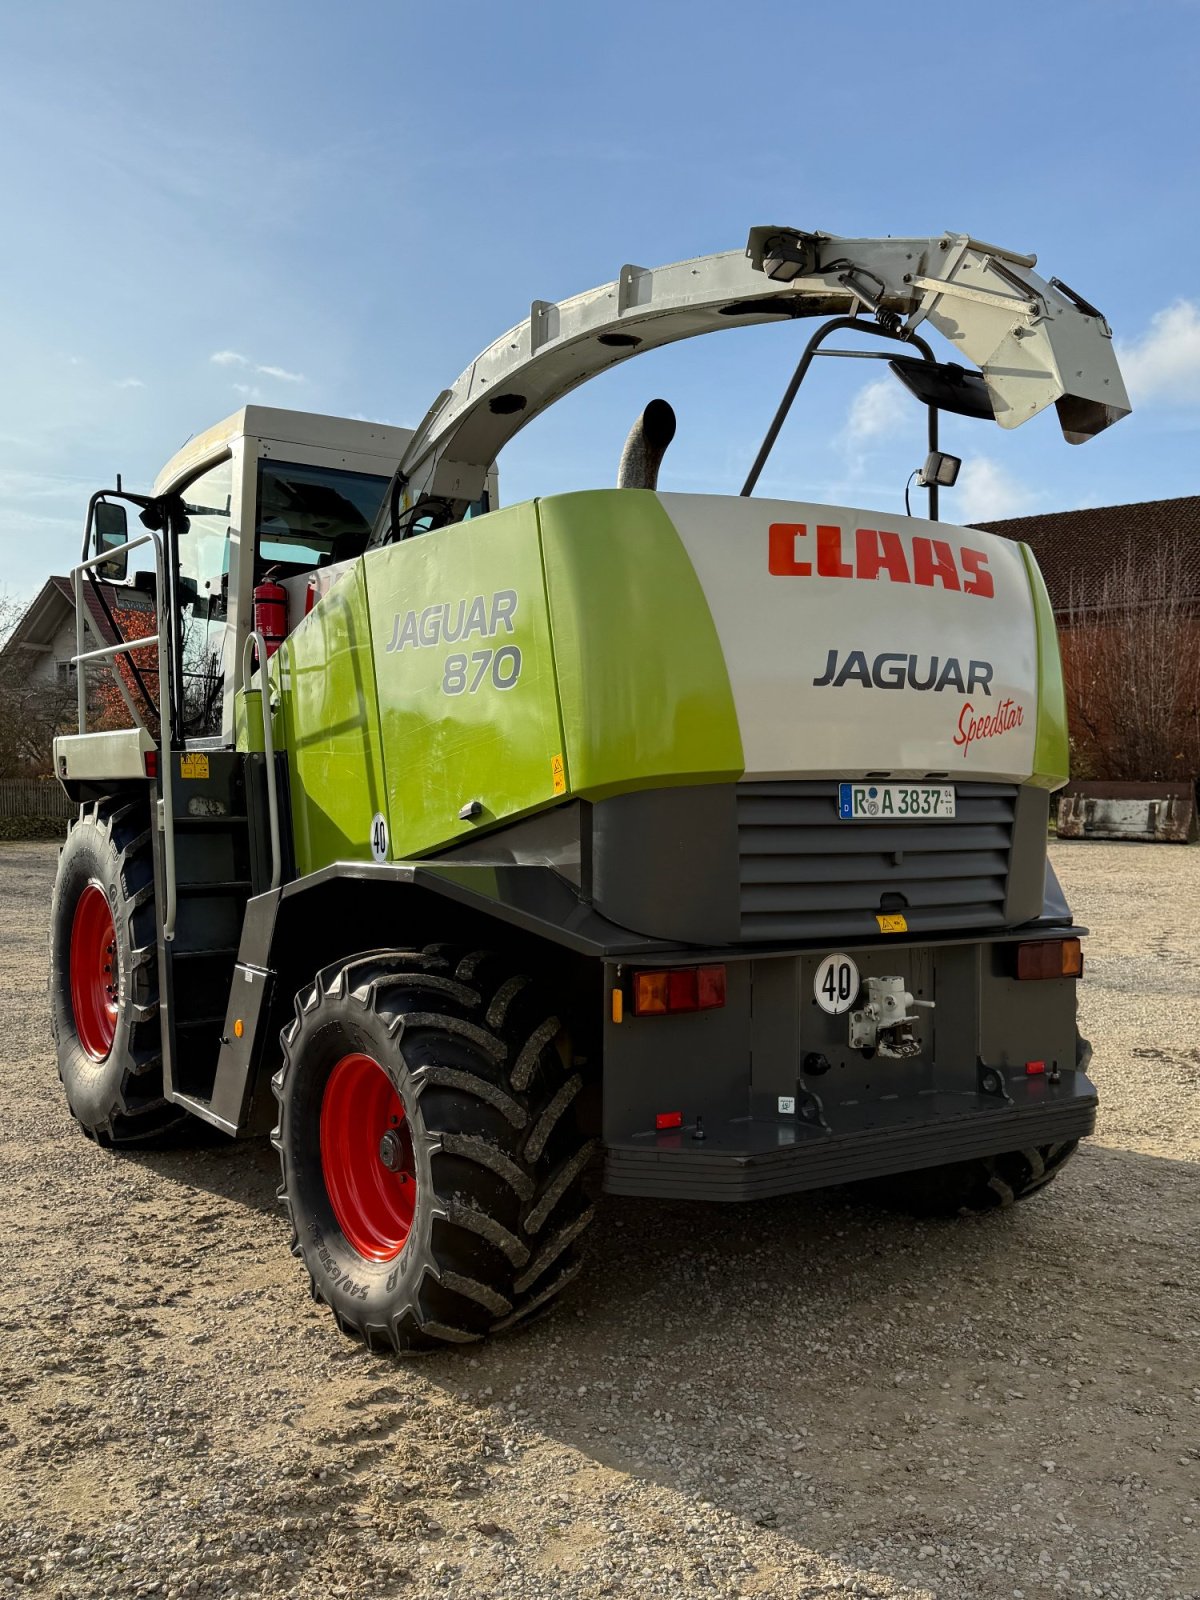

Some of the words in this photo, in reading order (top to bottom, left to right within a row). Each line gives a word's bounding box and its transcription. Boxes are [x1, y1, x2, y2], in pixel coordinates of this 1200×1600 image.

[768, 523, 995, 599] CLAAS
[386, 588, 519, 655] JAGUAR
[441, 644, 523, 697] 870
[813, 649, 994, 696] JAGUAR
[952, 698, 1025, 758] Speedstar
[853, 789, 867, 814] R
[881, 789, 894, 814] A
[898, 789, 941, 815] 3837
[373, 820, 386, 855] 40
[822, 962, 851, 1002] 40
